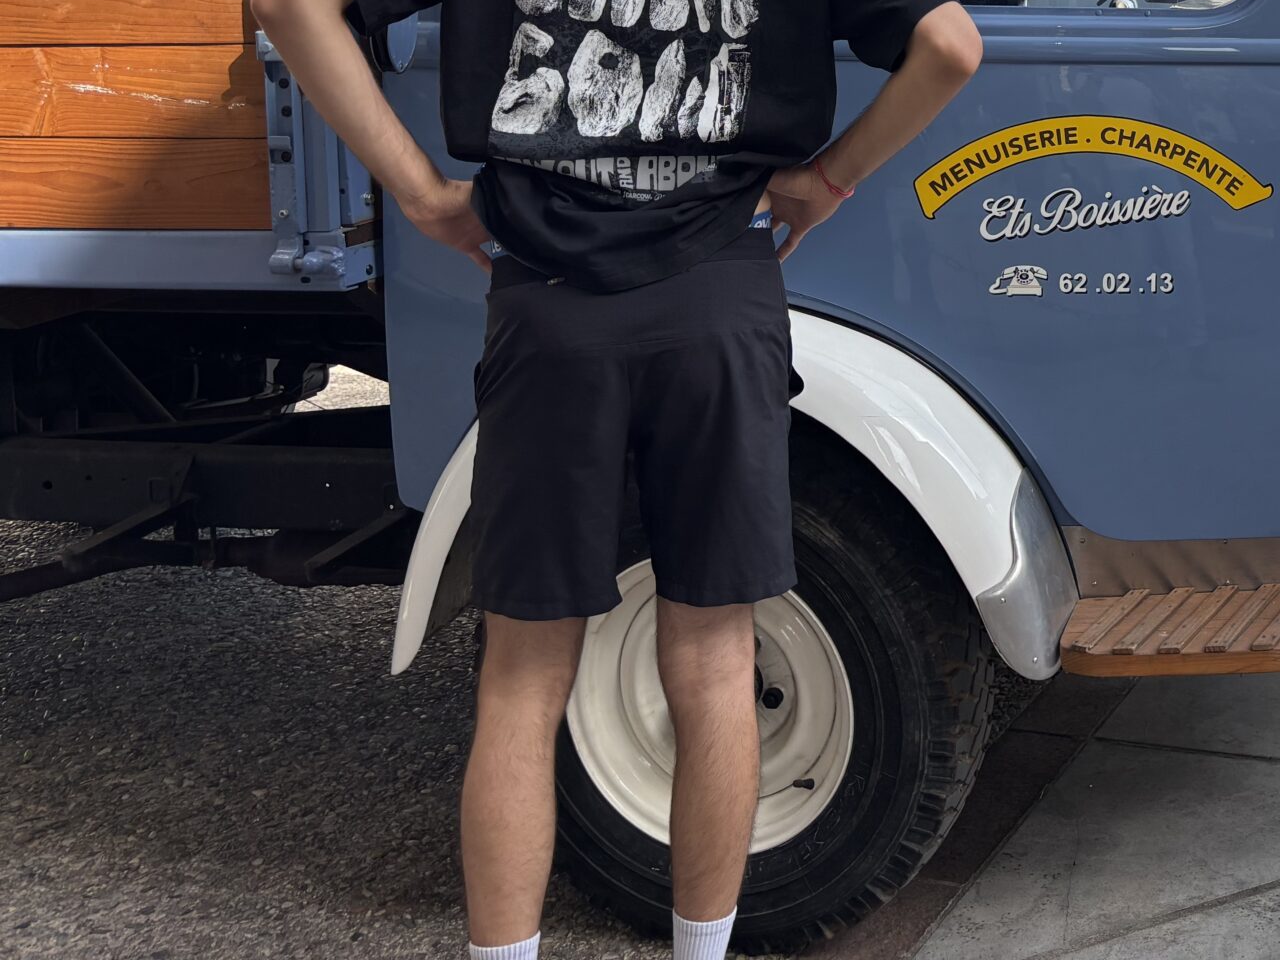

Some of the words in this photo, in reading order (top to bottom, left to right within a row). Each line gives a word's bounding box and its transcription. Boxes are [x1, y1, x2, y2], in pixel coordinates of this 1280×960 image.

[928, 126, 1079, 197] MENUISERIE
[1099, 126, 1245, 198] CHARPENTE
[979, 195, 1034, 241] Ets
[1033, 184, 1191, 235] Boissière
